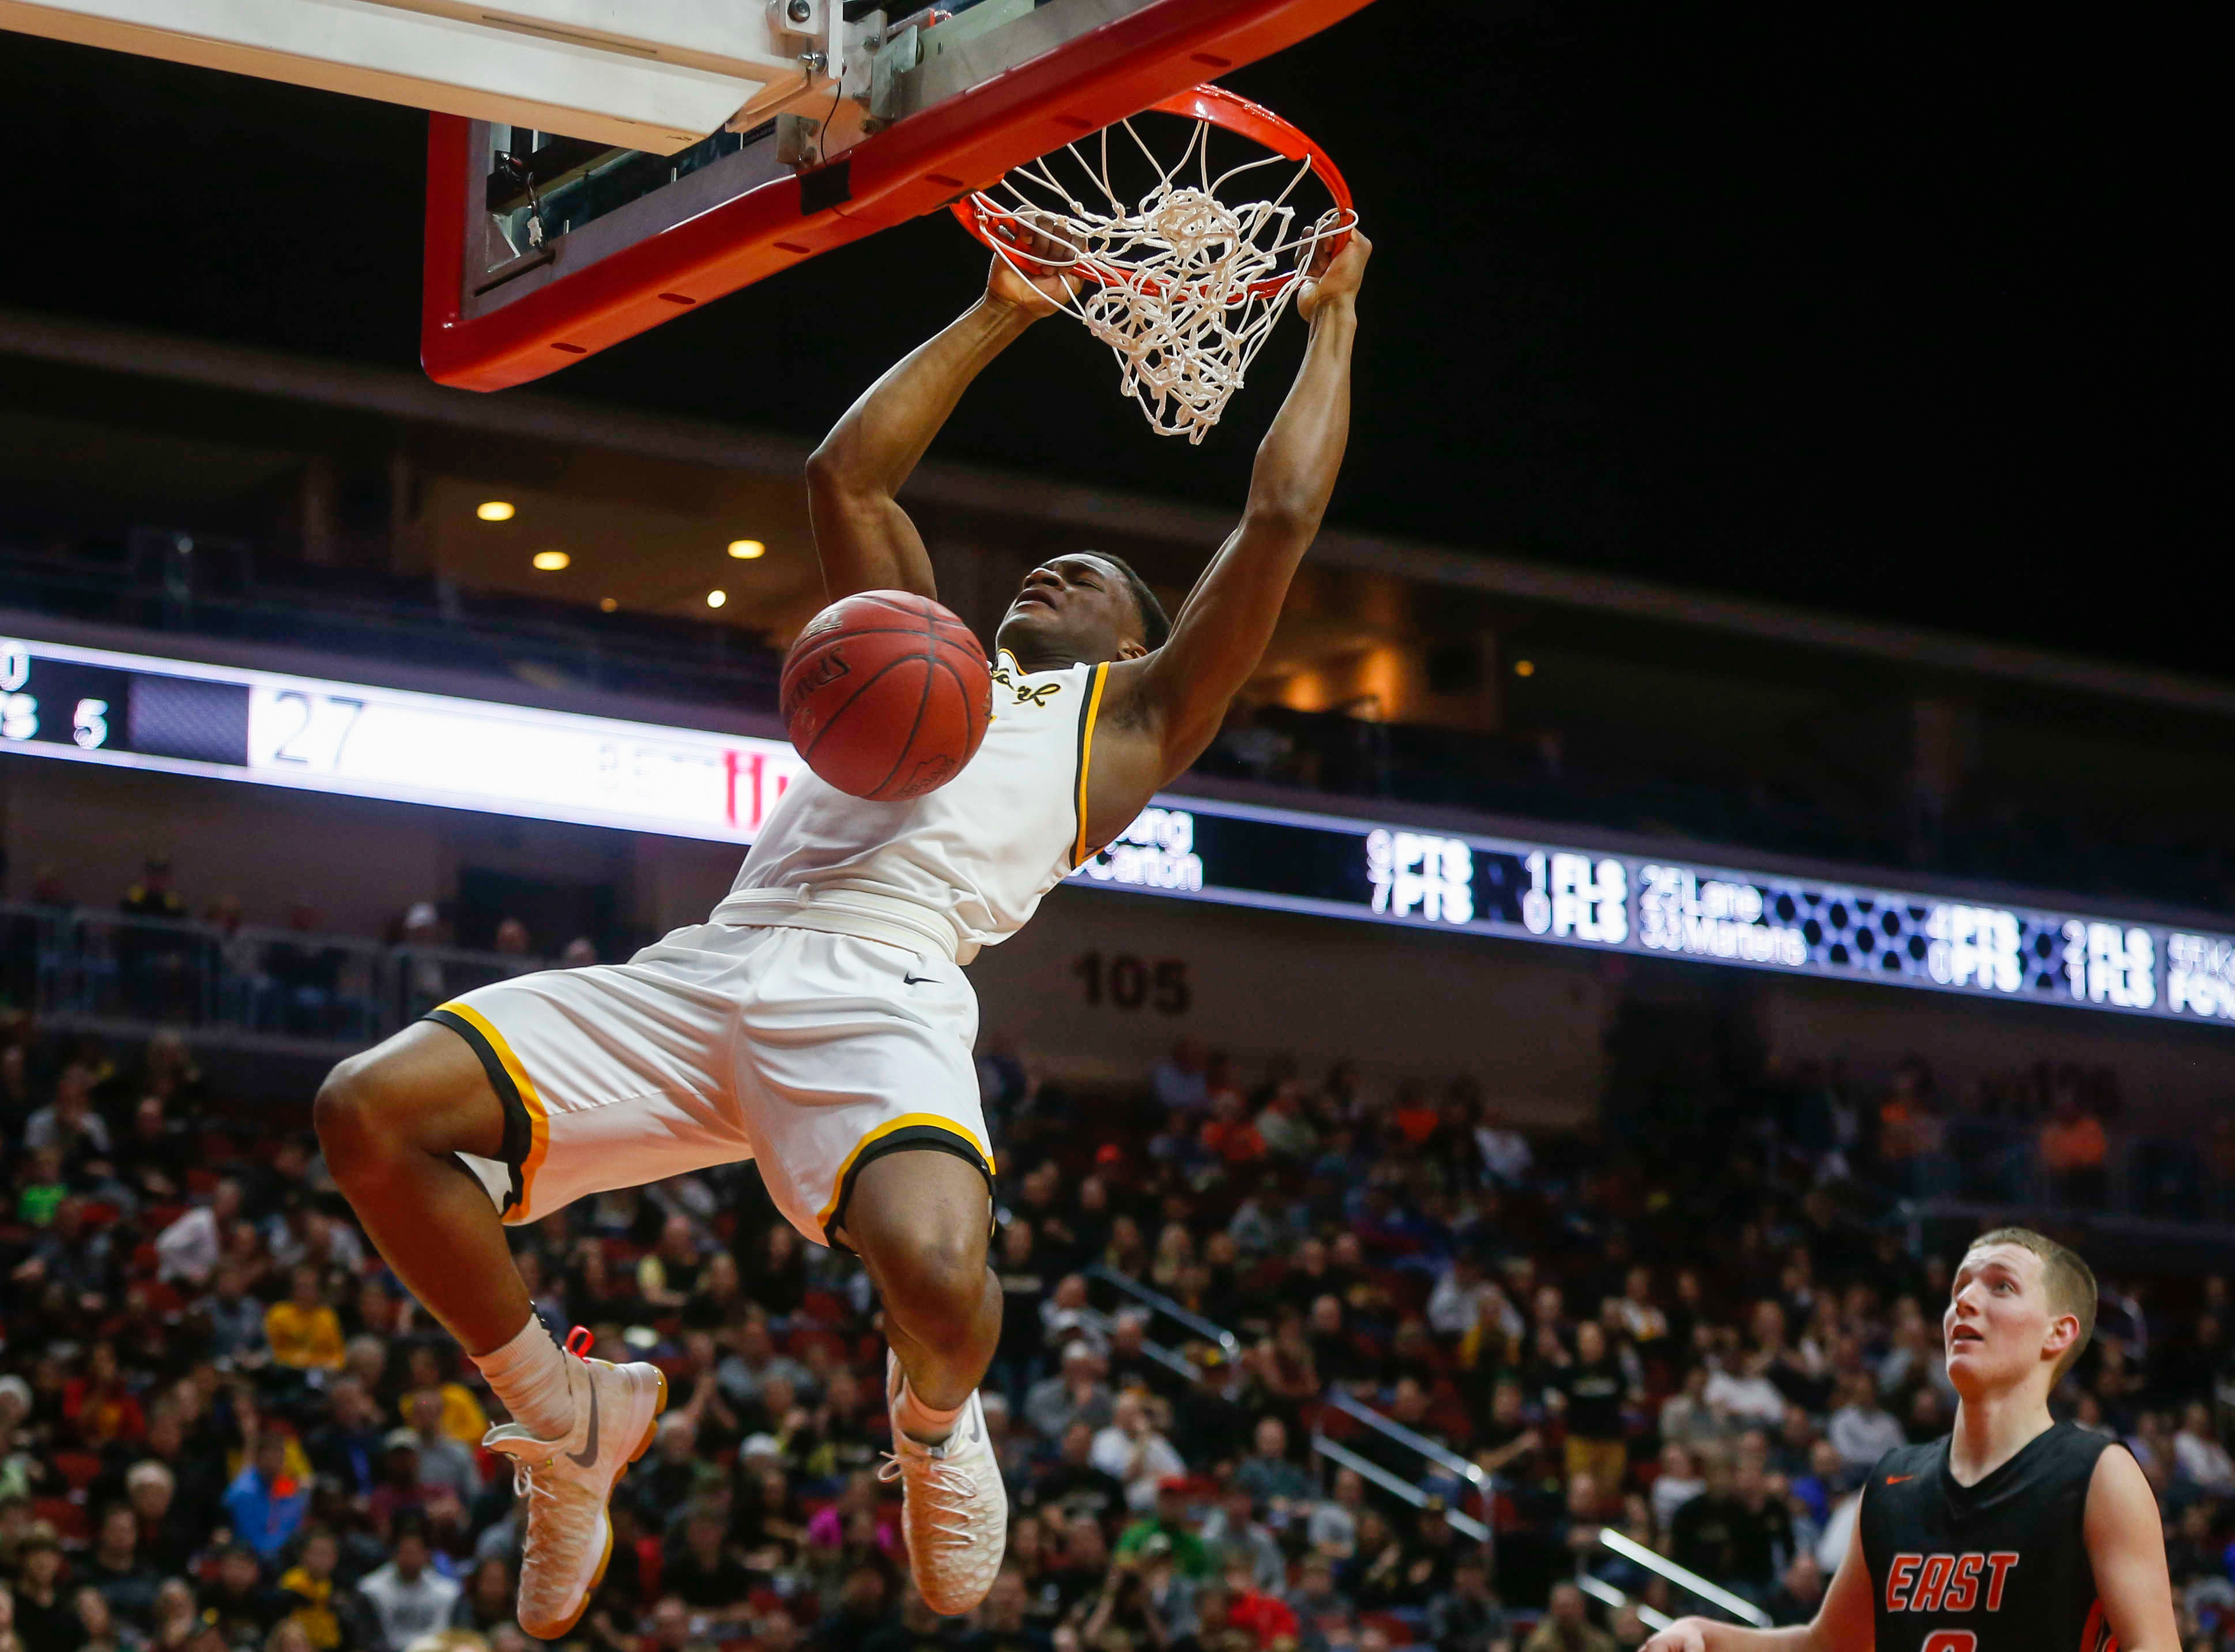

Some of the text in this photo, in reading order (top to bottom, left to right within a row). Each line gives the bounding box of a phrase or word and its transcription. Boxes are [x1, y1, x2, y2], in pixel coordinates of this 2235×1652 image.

[73, 698, 108, 750] 5
[275, 691, 368, 774] 27
[1525, 850, 1546, 891] 1
[1074, 949, 1191, 1015] 105
[1886, 1551, 2020, 1612] EAST
